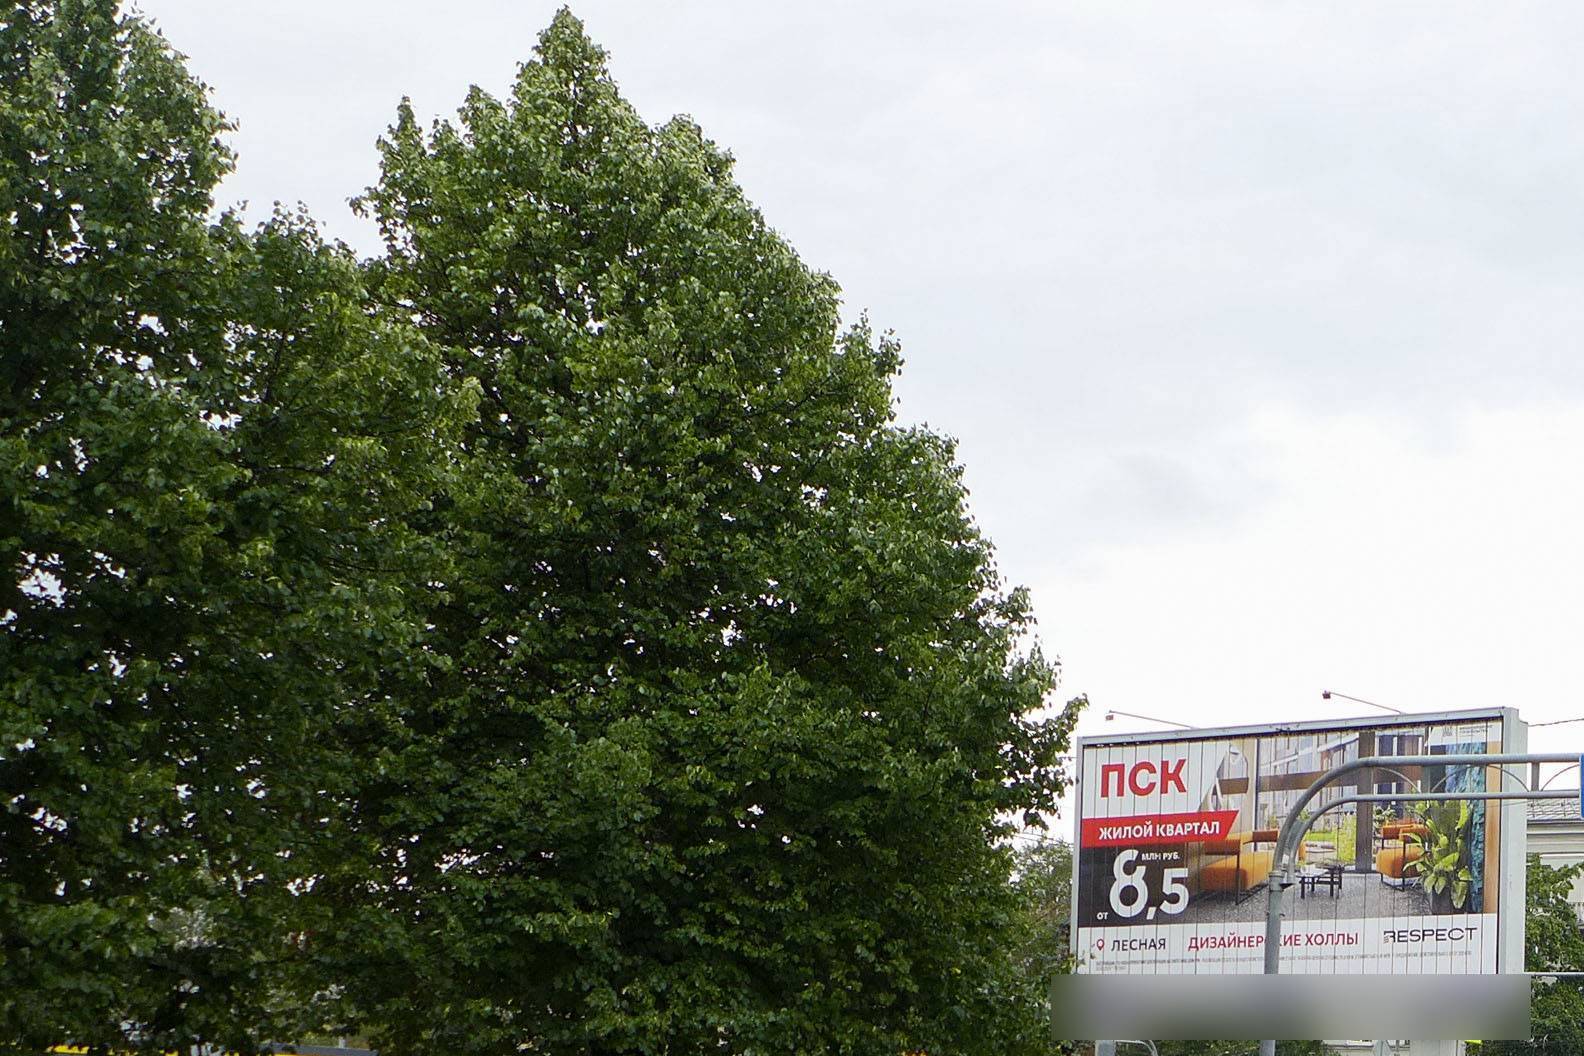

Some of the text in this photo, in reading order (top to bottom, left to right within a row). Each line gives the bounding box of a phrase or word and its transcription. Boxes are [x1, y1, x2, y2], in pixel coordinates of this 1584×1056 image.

[1100, 758, 1187, 798] ПСК
[1098, 820, 1220, 840] ЖИЛОЙ КВАРТАЛ
[1141, 852, 1161, 861] МЛН
[1109, 849, 1190, 920] 8,5
[1111, 938, 1166, 951] ЛЕСНАЯ
[1188, 931, 1359, 951] ДИЗАЙНЕРИЕ ХОЛЛЫ
[1383, 927, 1478, 944] RESPECT
